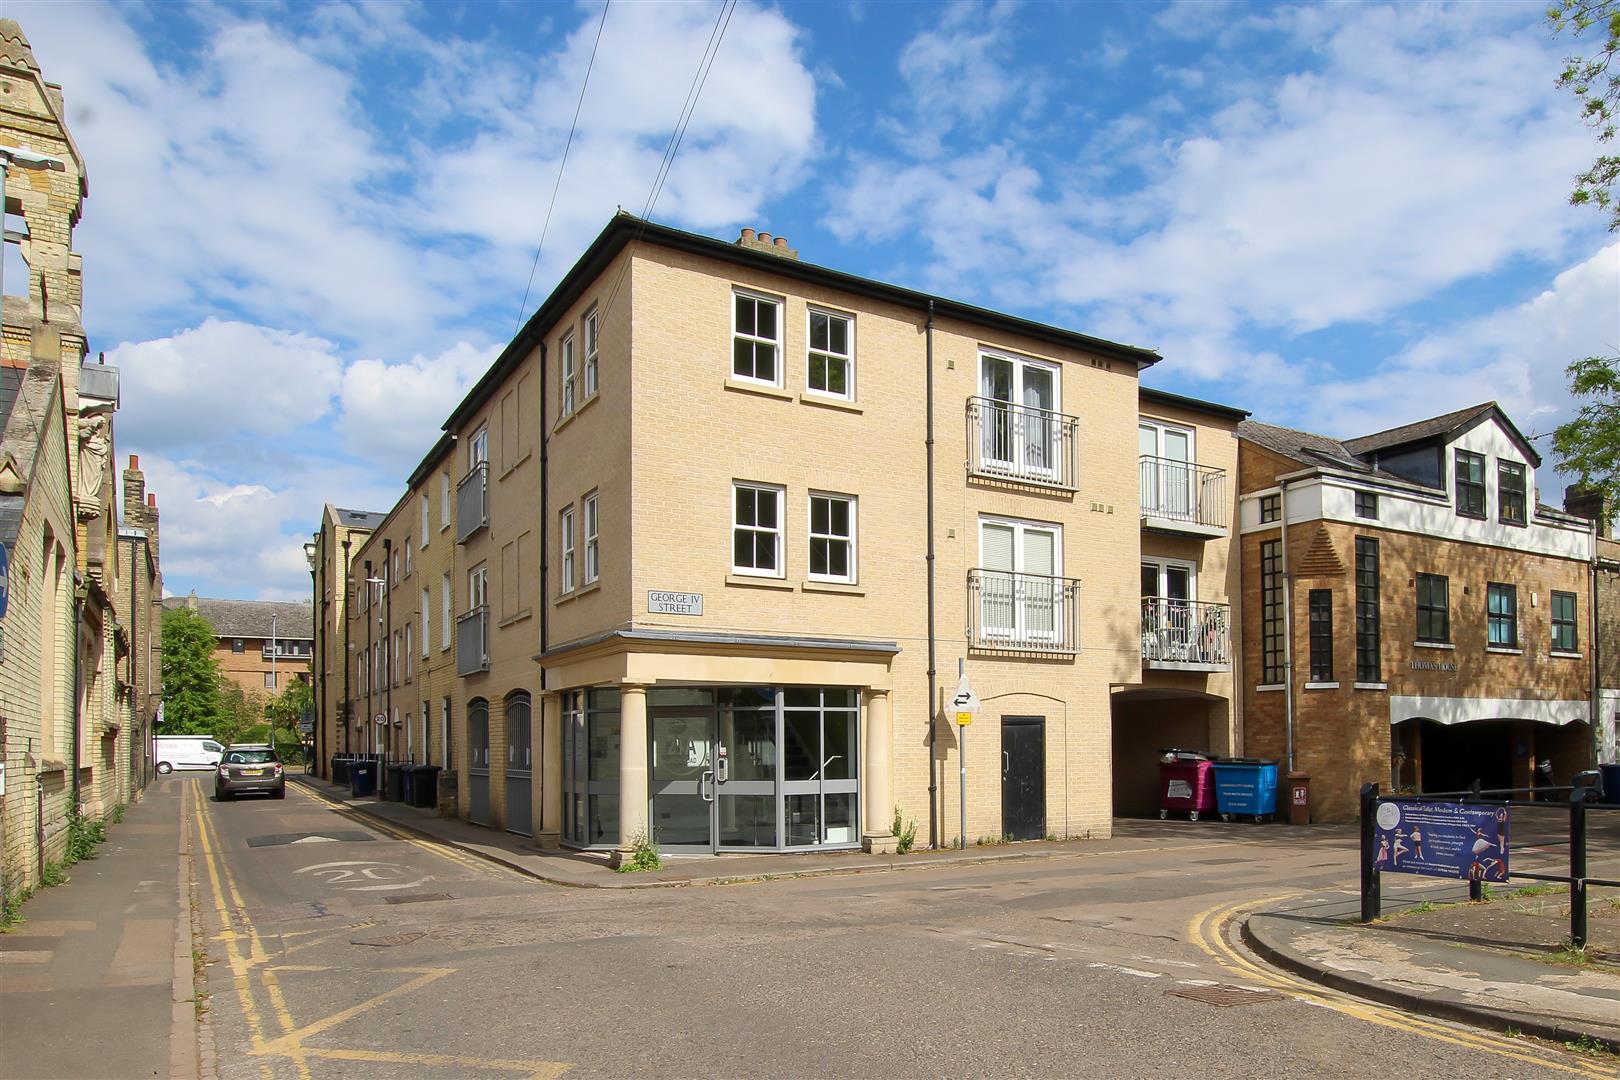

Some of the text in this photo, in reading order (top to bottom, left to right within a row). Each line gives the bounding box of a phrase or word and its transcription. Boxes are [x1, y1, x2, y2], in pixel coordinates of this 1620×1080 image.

[650, 592, 700, 604] GEORGE IV
[658, 603, 693, 613] STREET
[1410, 660, 1438, 670] THOMAS
[1459, 808, 1495, 818] Contemporary
[312, 866, 407, 884] 20
